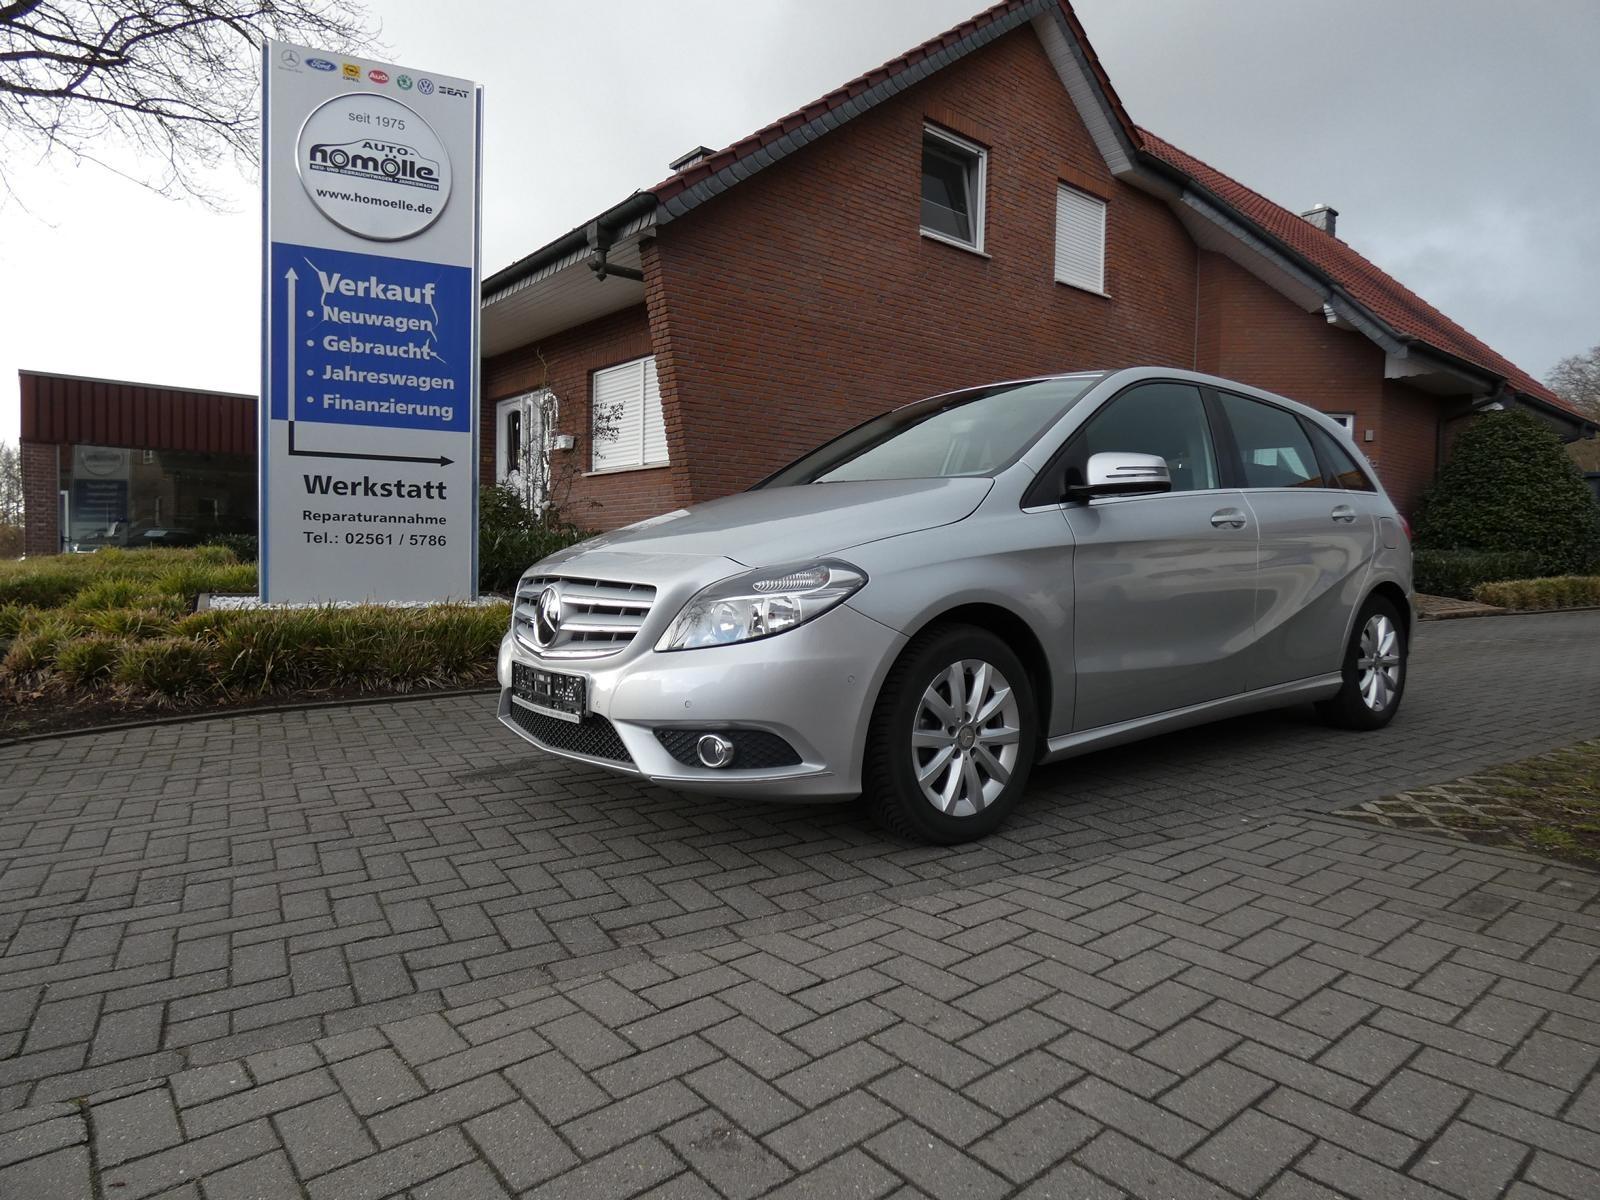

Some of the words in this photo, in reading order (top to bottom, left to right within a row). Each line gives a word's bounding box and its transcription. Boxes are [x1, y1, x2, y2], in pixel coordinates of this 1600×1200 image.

[369, 71, 389, 82] Audi
[439, 85, 469, 98] SEAT
[348, 112, 371, 124] seit
[375, 116, 406, 131] 1975
[362, 140, 415, 156] AUTO-
[316, 188, 433, 214] www.homoelle.de
[318, 270, 436, 305] Verkauf
[322, 305, 433, 332] Neuwagen
[322, 365, 455, 391] Jahreswagen
[322, 394, 454, 421] Finanzierung
[303, 474, 447, 500] Werkstatt
[302, 510, 447, 525] Reparaturannahme
[303, 531, 339, 544] Tel.:
[345, 532, 393, 545] 02561
[409, 534, 447, 546] 5786
